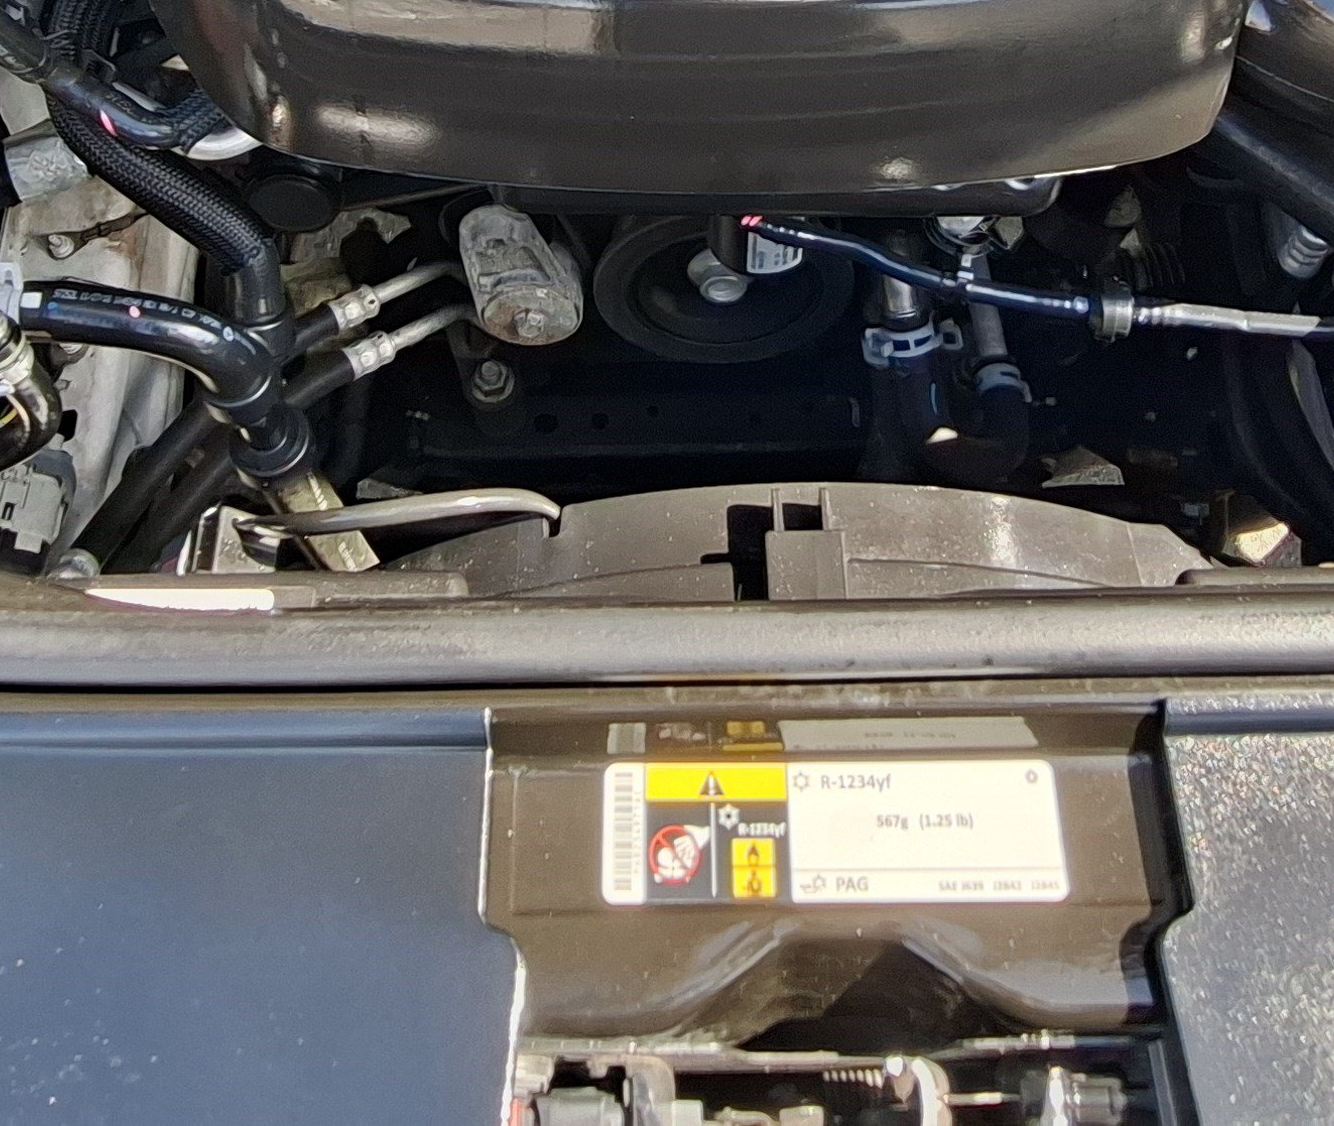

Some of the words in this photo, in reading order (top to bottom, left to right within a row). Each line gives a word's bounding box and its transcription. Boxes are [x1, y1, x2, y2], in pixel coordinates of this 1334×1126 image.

[820, 772, 892, 792] R-1234yf
[876, 814, 909, 830] 567g
[919, 813, 953, 830] (1.25
[956, 813, 974, 829] lb)
[835, 876, 869, 892] PAG
